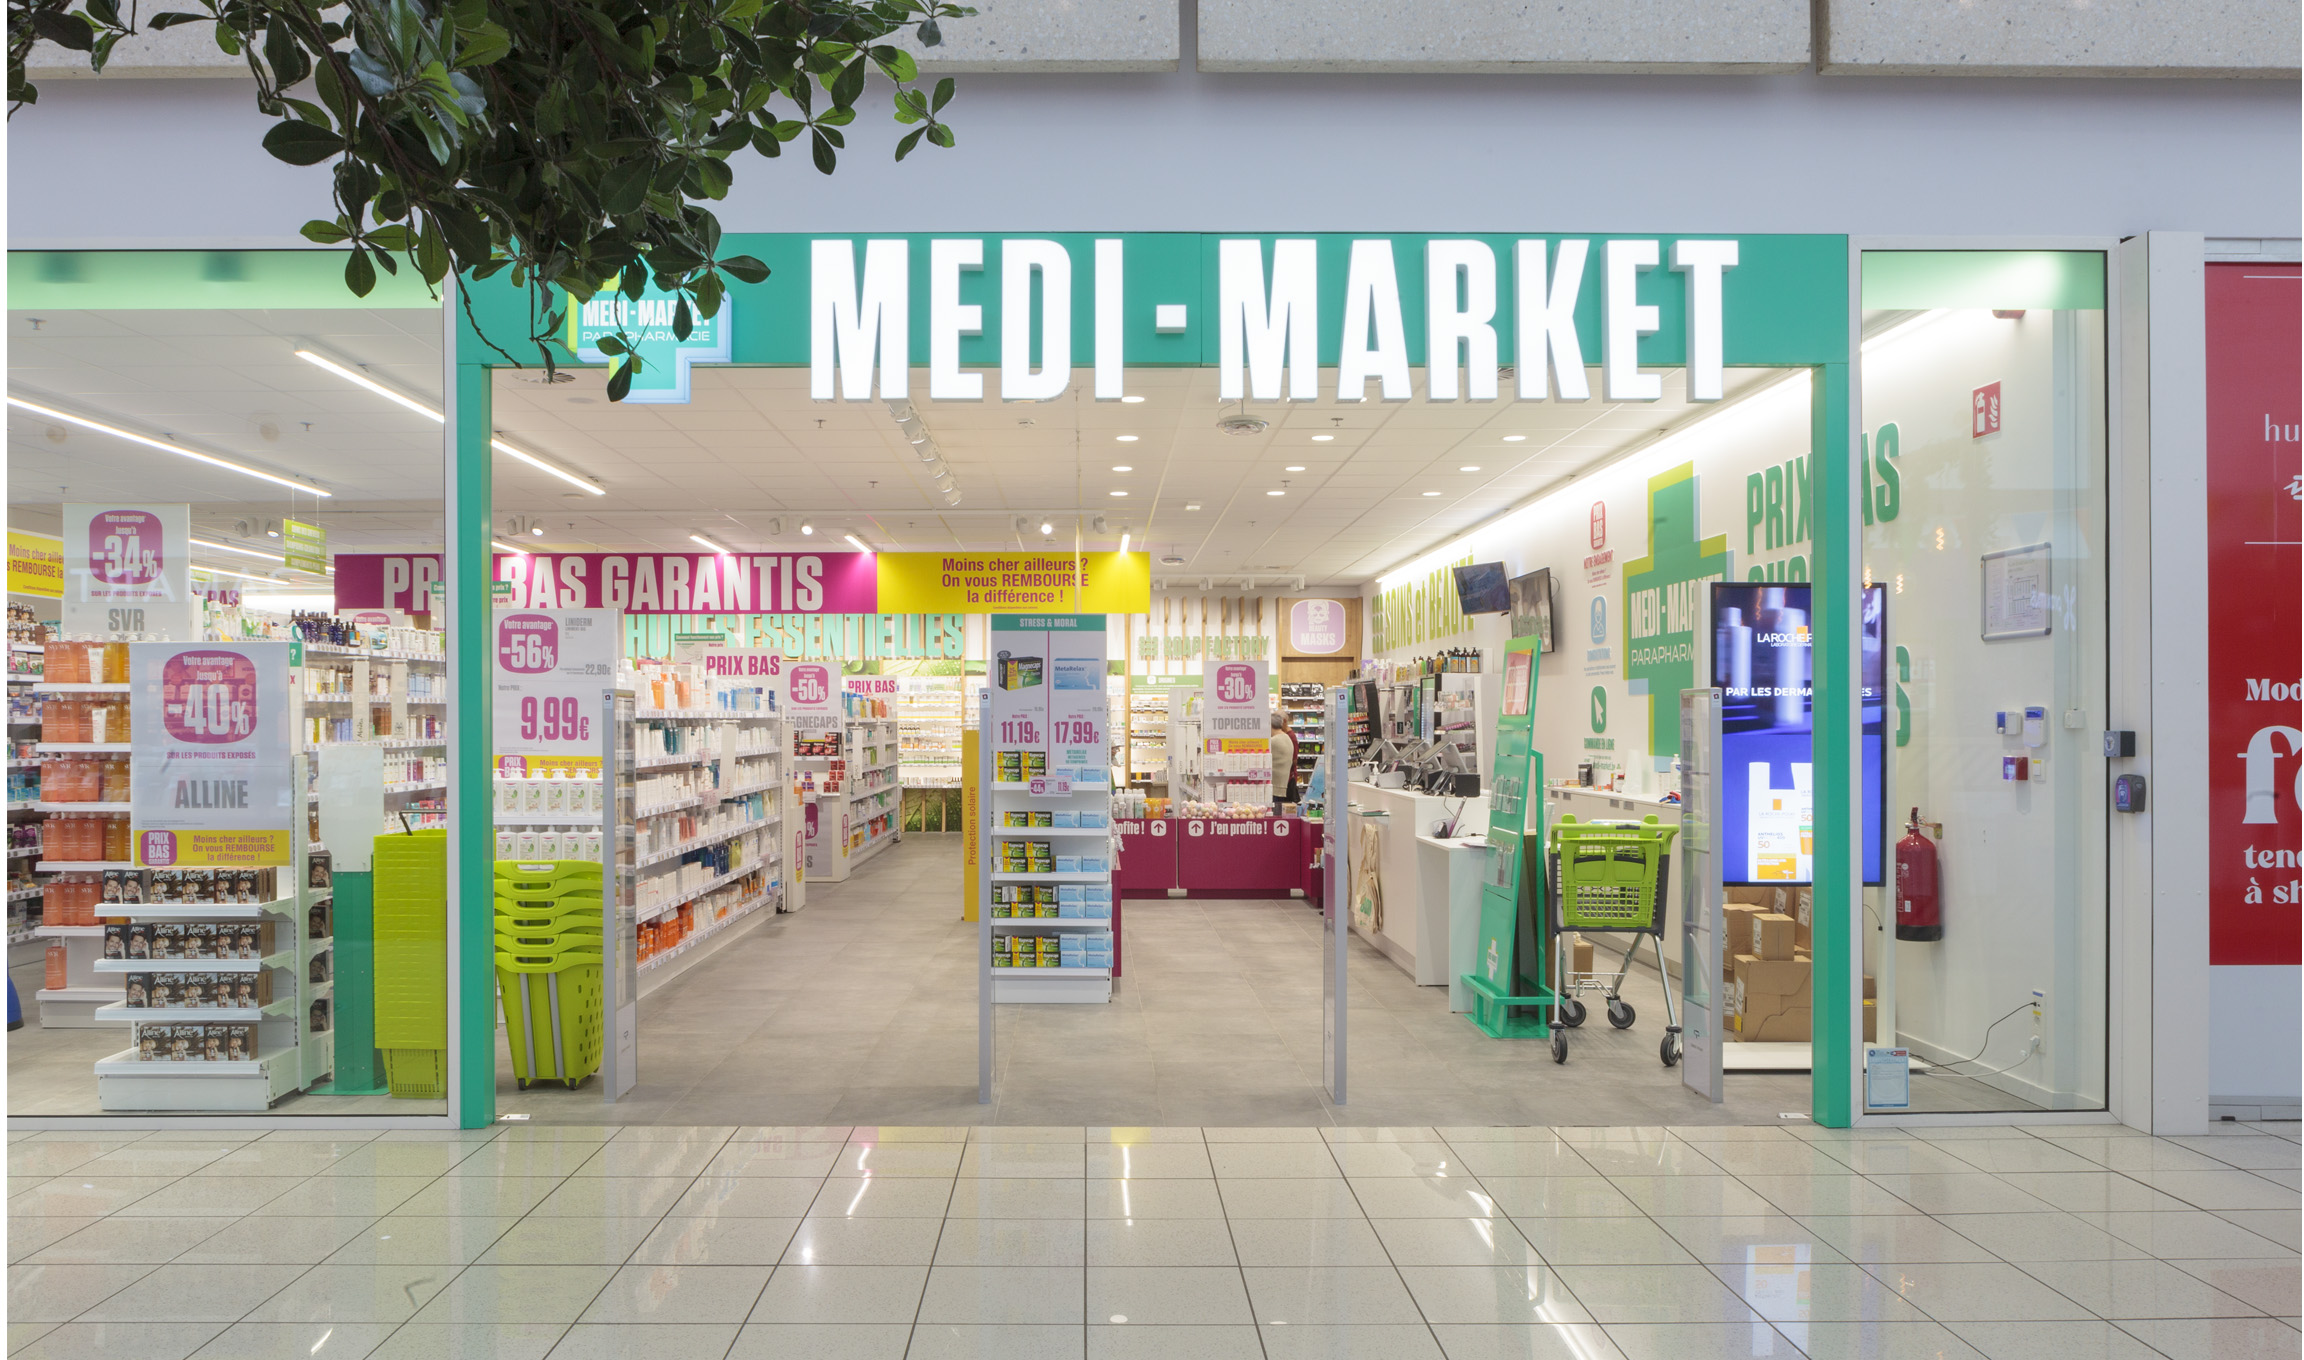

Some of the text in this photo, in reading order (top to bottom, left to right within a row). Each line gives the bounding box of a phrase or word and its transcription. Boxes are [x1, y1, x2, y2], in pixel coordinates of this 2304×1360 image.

[583, 300, 628, 326] MEDI
[638, 300, 710, 326] MARE
[811, 239, 1739, 402] MEDI - MARKET
[583, 332, 710, 341] PARPHARMCIE
[9, 544, 30, 559] Moins
[32, 549, 46, 561] cher
[93, 535, 157, 578] -34%
[12, 562, 56, 578] REMBOURSE
[942, 558, 1088, 572] Moins cher ailleurs ?
[383, 556, 823, 611] PR BAS GARANTIS
[942, 574, 1089, 587] On vous REMBOURSE
[967, 590, 979, 603] la
[984, 589, 1055, 603] différence
[108, 608, 144, 631] SVR
[1631, 587, 1660, 639] MEDI
[504, 620, 521, 629] Votre
[1020, 618, 1077, 628] STRESS & MORAL
[1301, 633, 1336, 646] MASKS
[1757, 633, 1770, 643] LA
[501, 634, 554, 669] -56%
[1206, 636, 1269, 656] FACTORY
[183, 656, 200, 665] Votre
[706, 656, 780, 675] PRIX BAS
[792, 679, 825, 700] -50%
[848, 680, 895, 693] PRIX BAS
[1218, 677, 1253, 699] -30%
[1726, 688, 1748, 696] PAR
[1751, 688, 1771, 696] LES
[168, 684, 250, 735] -40%
[521, 696, 589, 743] 9,99€
[785, 716, 838, 728] AGNECAPS
[1212, 718, 1260, 730] TOPICREM
[1001, 721, 1040, 745] 11,19€
[1054, 721, 1099, 745] 17,99€
[505, 757, 521, 766] PRIX
[175, 780, 248, 808] ALLINE
[968, 787, 976, 865] Protection solaire
[1115, 821, 1140, 834] ofite
[1210, 821, 1229, 834] J'en
[1230, 821, 1263, 836] profite
[149, 832, 169, 844] PRIX
[194, 835, 274, 843] Moins cher ailleurs ?
[149, 845, 169, 858] BAS
[193, 844, 204, 852] On
[226, 844, 275, 852] REMBOURSE
[207, 853, 215, 861] la
[217, 853, 255, 861] différence
[2244, 876, 2263, 904] à
